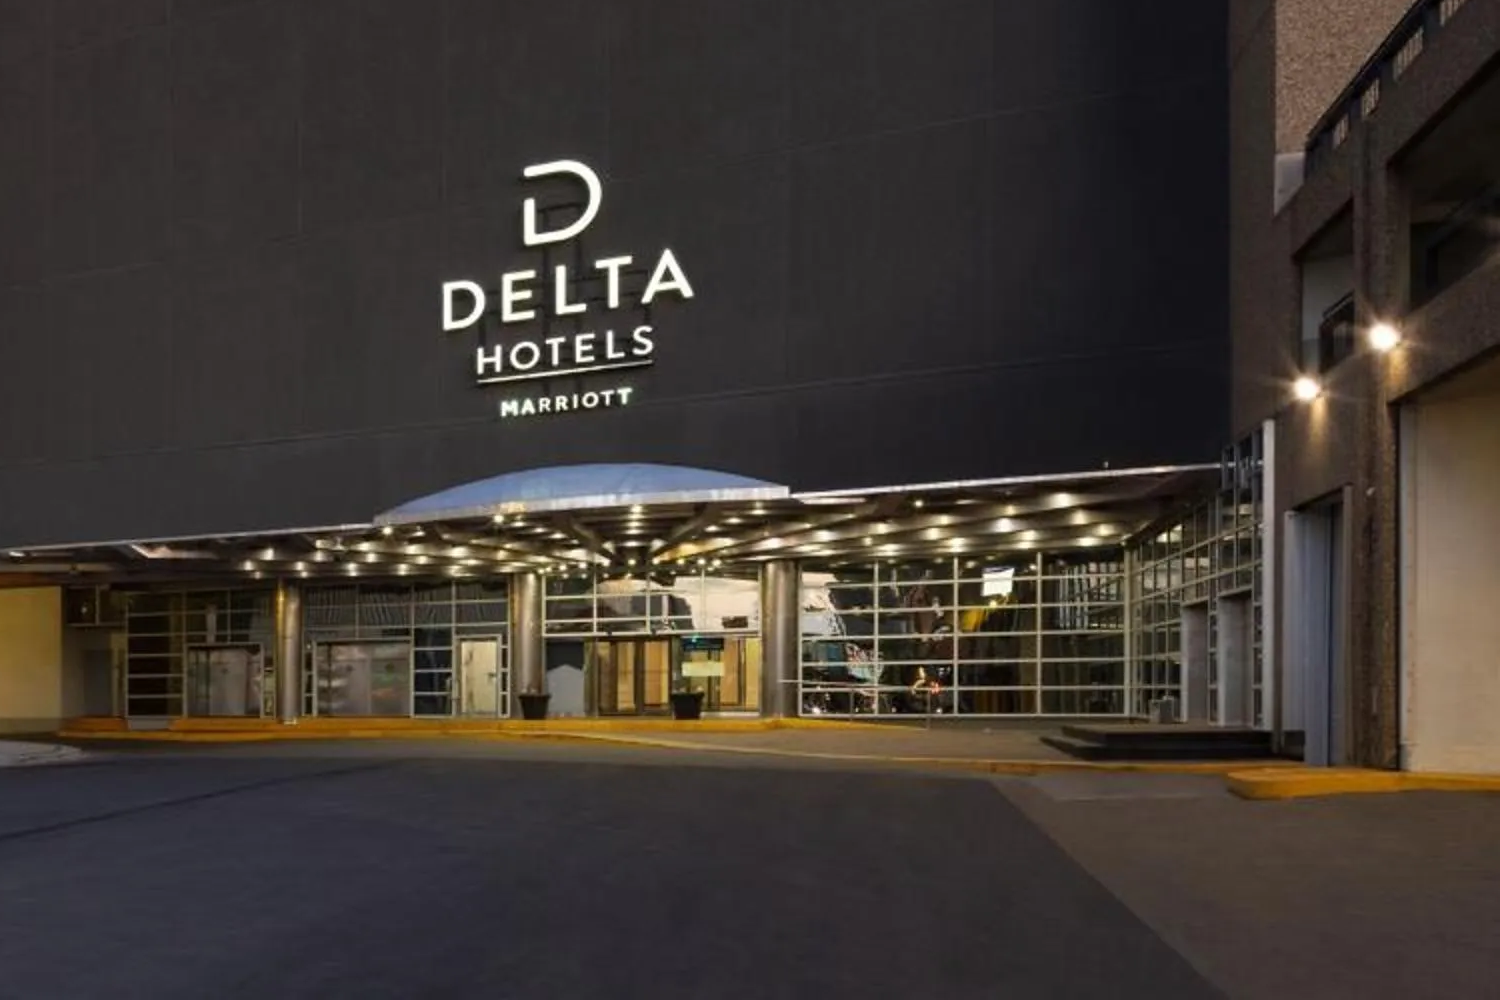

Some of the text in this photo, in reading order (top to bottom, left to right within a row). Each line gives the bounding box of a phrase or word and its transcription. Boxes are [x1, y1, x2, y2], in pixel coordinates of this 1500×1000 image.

[441, 248, 695, 331] DELTA
[476, 325, 654, 375] HOTELS
[499, 386, 633, 418] MARRIOTT
